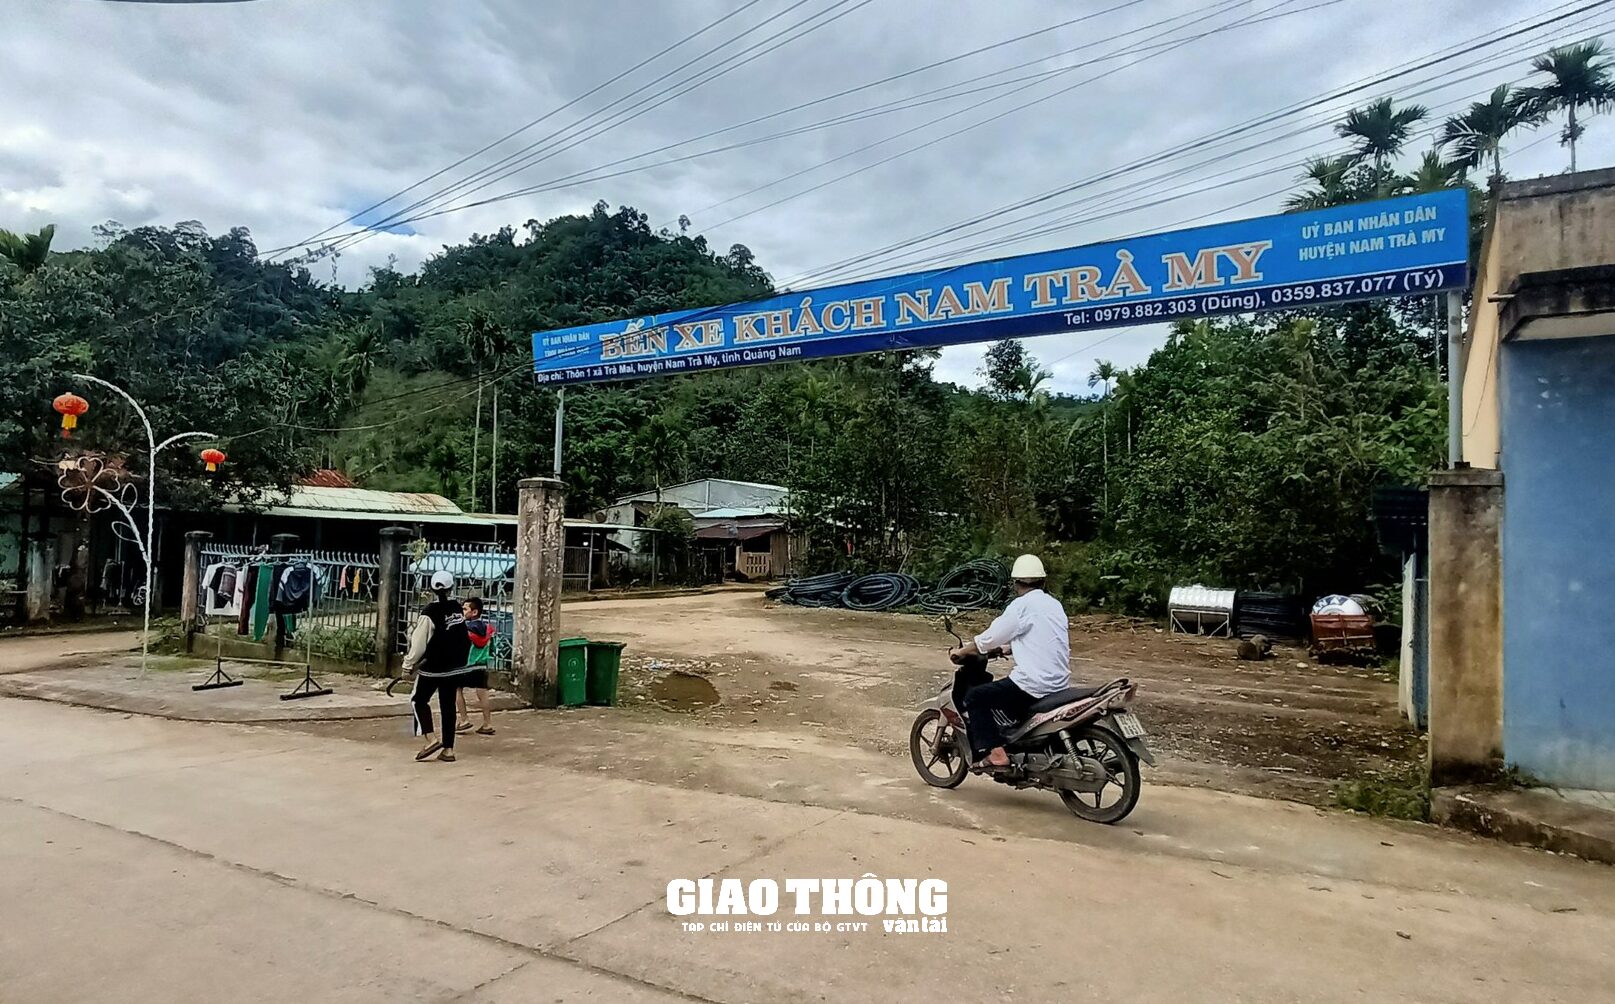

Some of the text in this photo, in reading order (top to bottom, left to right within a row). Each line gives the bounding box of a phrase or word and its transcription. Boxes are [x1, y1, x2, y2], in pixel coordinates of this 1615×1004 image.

[1324, 219, 1354, 236] BAN
[1358, 211, 1400, 231] NHÂN
[1404, 206, 1437, 225] DÂN
[1299, 227, 1446, 261] HUYỆN NAM TRÀ MY
[600, 240, 1272, 360] BẾN XE KHÁCH NAM TRÀ MY
[1064, 268, 1444, 325] Tel: 0979.882.303 (Dũng), 0359.837.077 (Tý)
[566, 368, 585, 379] Thôn
[604, 365, 617, 376] Trà
[619, 363, 636, 374] Mai,
[637, 360, 664, 373] huyện
[665, 358, 686, 369] Nam
[687, 356, 702, 367] Trà
[704, 354, 720, 366] My,
[743, 347, 776, 360] Quảng
[778, 345, 801, 357] Nam
